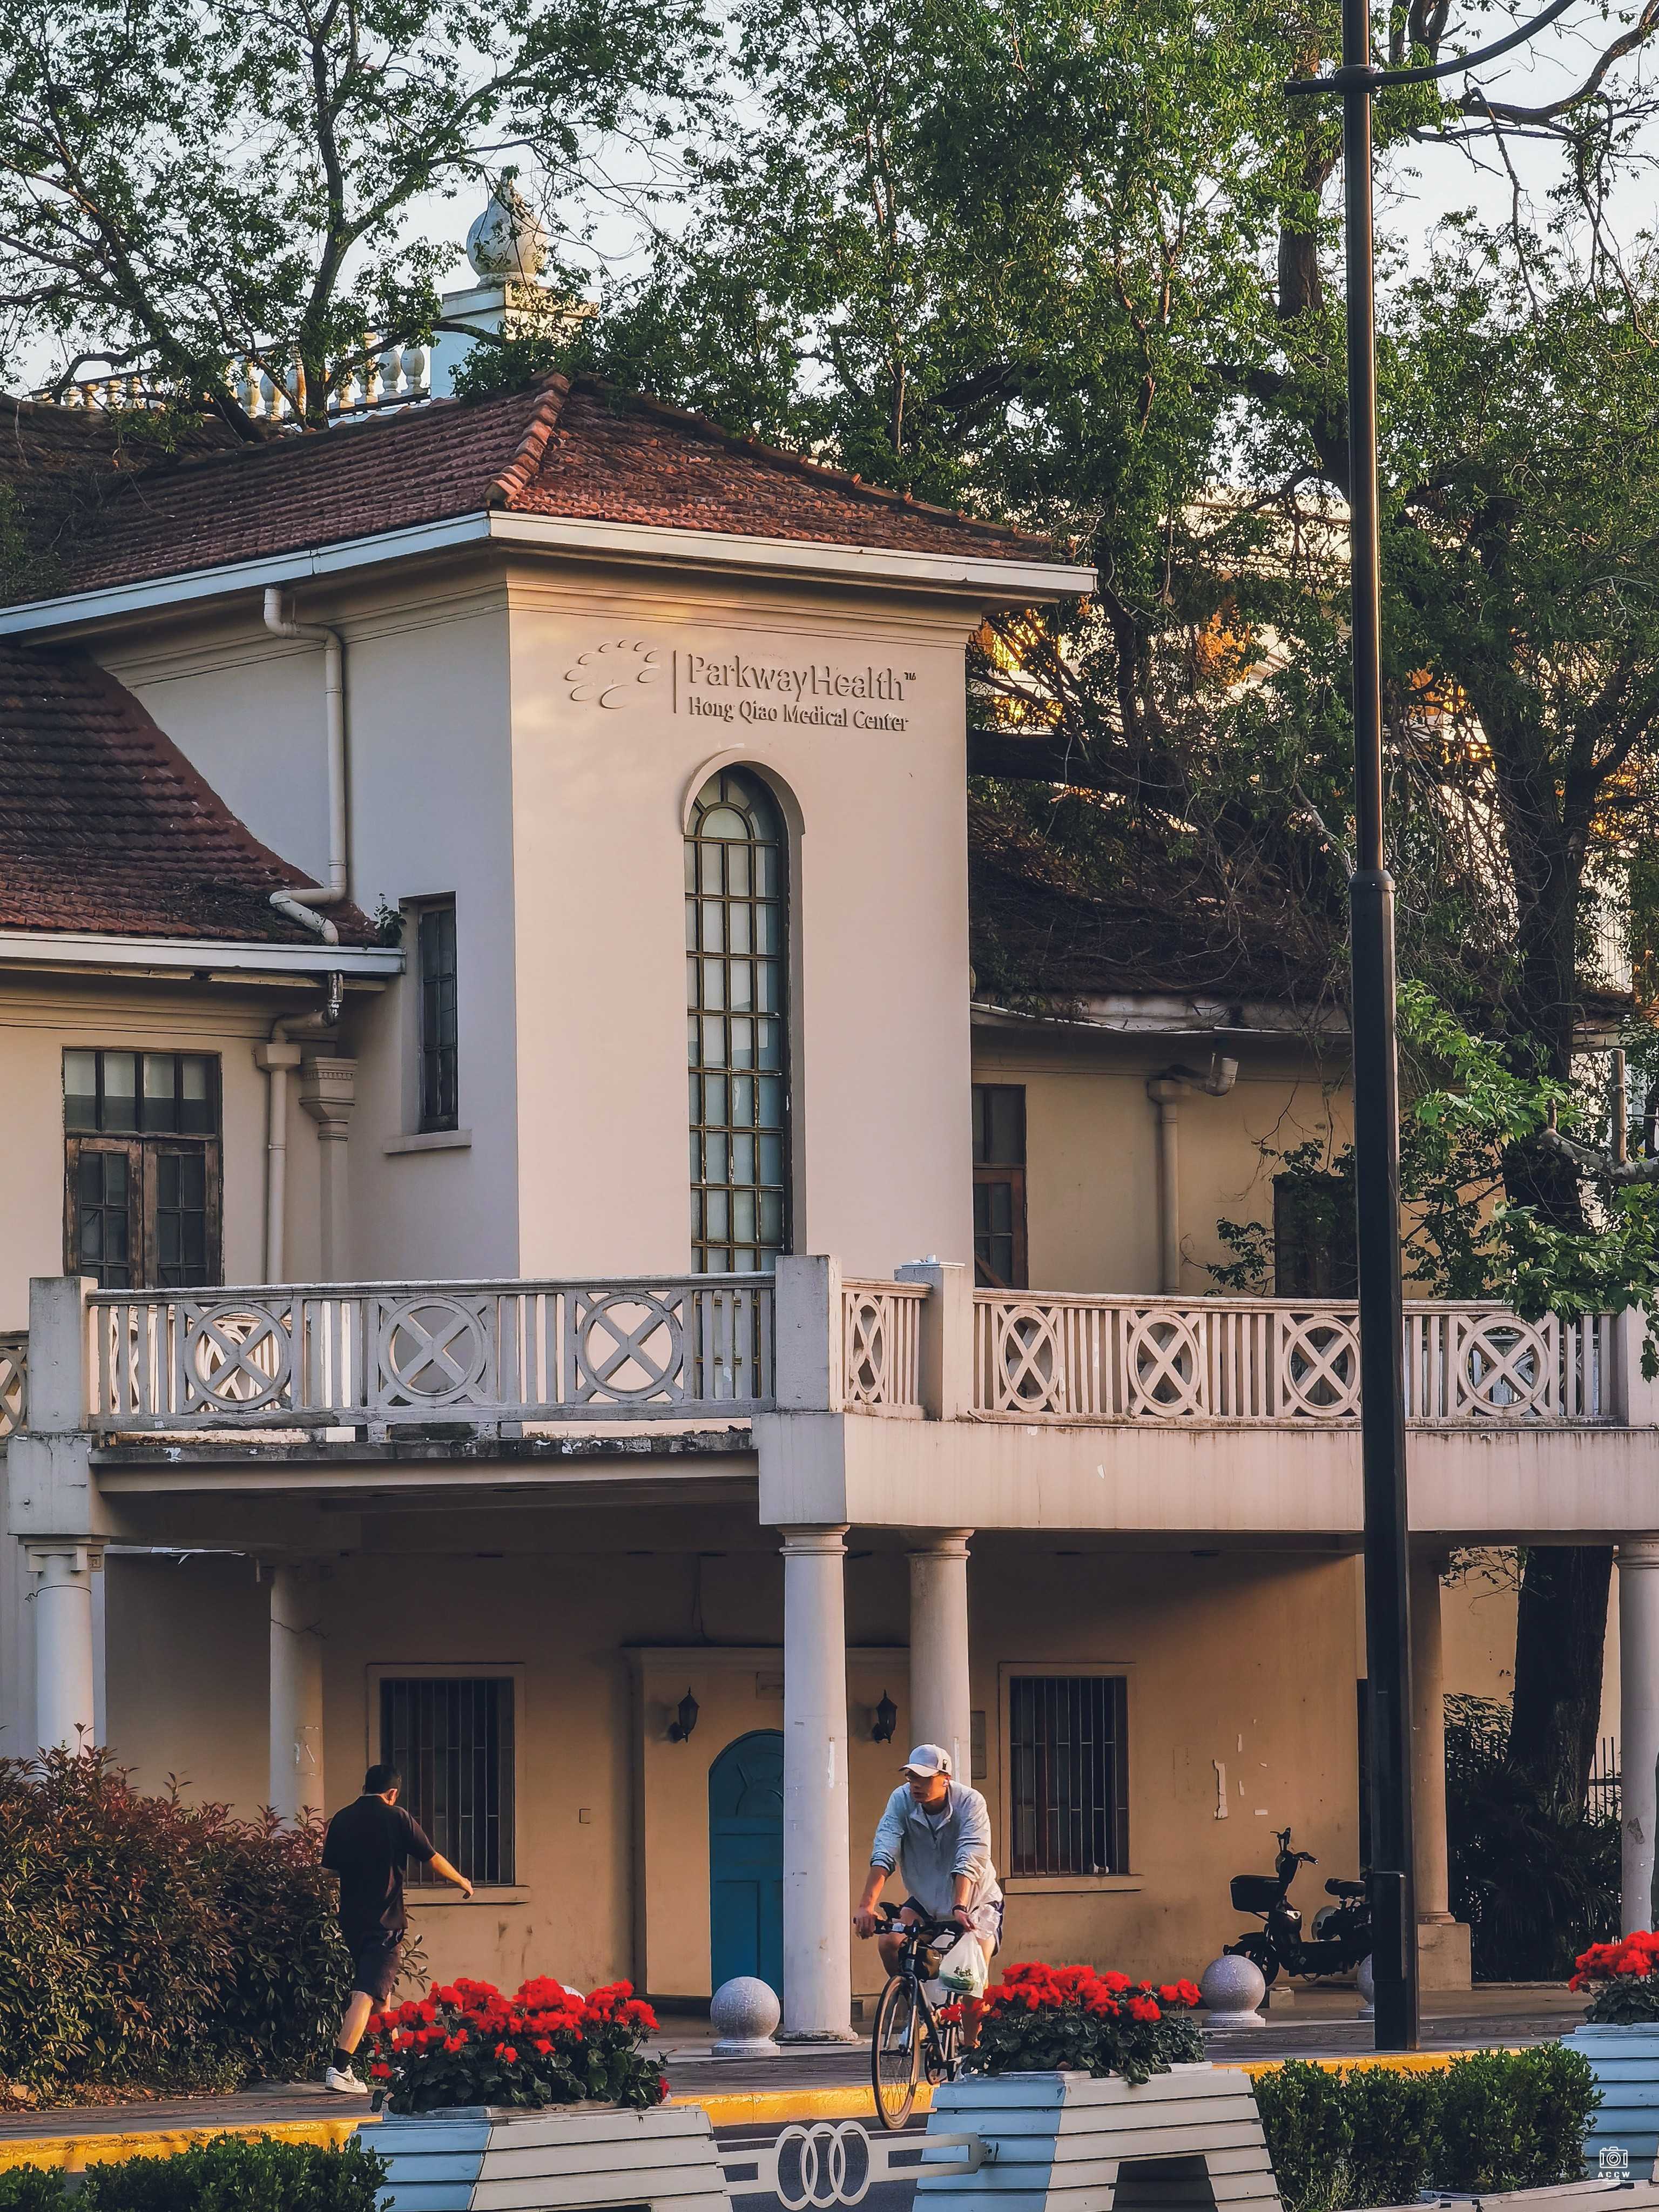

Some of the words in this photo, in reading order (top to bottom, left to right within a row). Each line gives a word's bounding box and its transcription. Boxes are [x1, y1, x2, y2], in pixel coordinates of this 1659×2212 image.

[686, 653, 905, 702] ParkwayHealth
[689, 696, 734, 723] Hong
[739, 699, 777, 724] Qiao
[783, 704, 848, 727] Medical
[853, 709, 909, 731] Center
